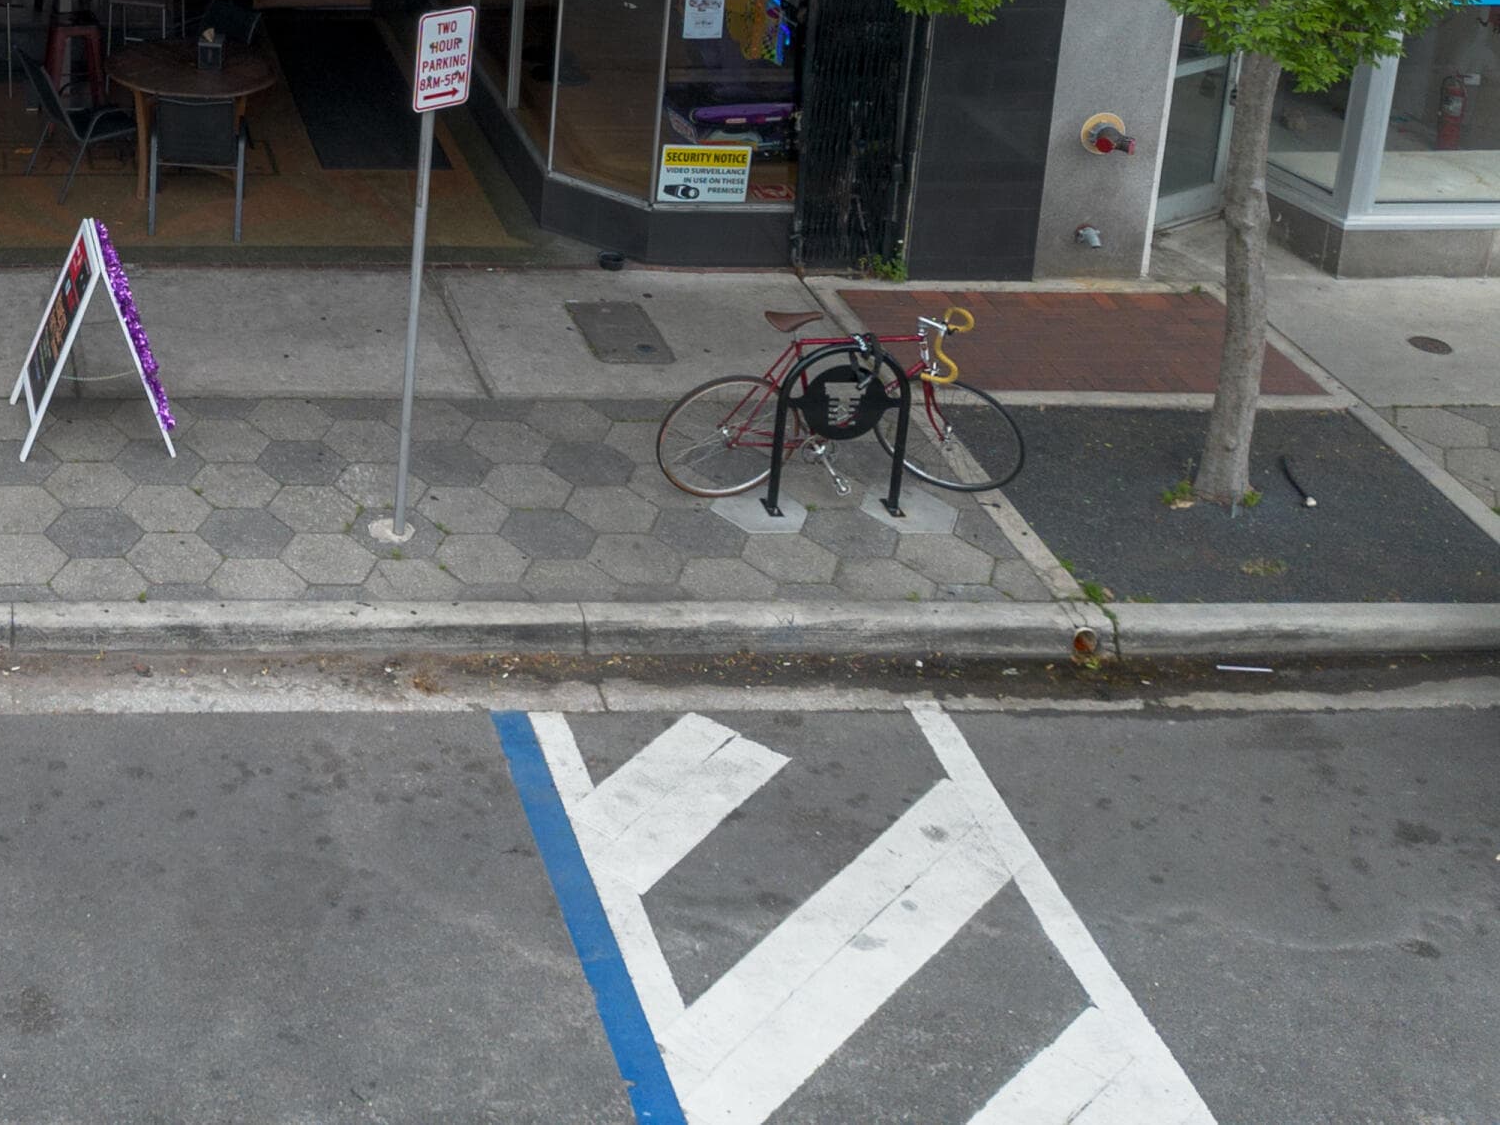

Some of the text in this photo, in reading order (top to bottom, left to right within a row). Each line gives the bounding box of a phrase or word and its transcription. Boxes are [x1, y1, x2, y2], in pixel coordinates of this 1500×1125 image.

[437, 20, 457, 35] TWO
[431, 38, 461, 54] HOUR
[422, 54, 467, 73] PARKING
[419, 72, 466, 92] 8AM-5PM
[666, 152, 748, 164] SECURITY NOTICE
[691, 167, 746, 175] SURVEILLANCE
[721, 177, 745, 185] THESE
[707, 187, 744, 195] PREMISES
